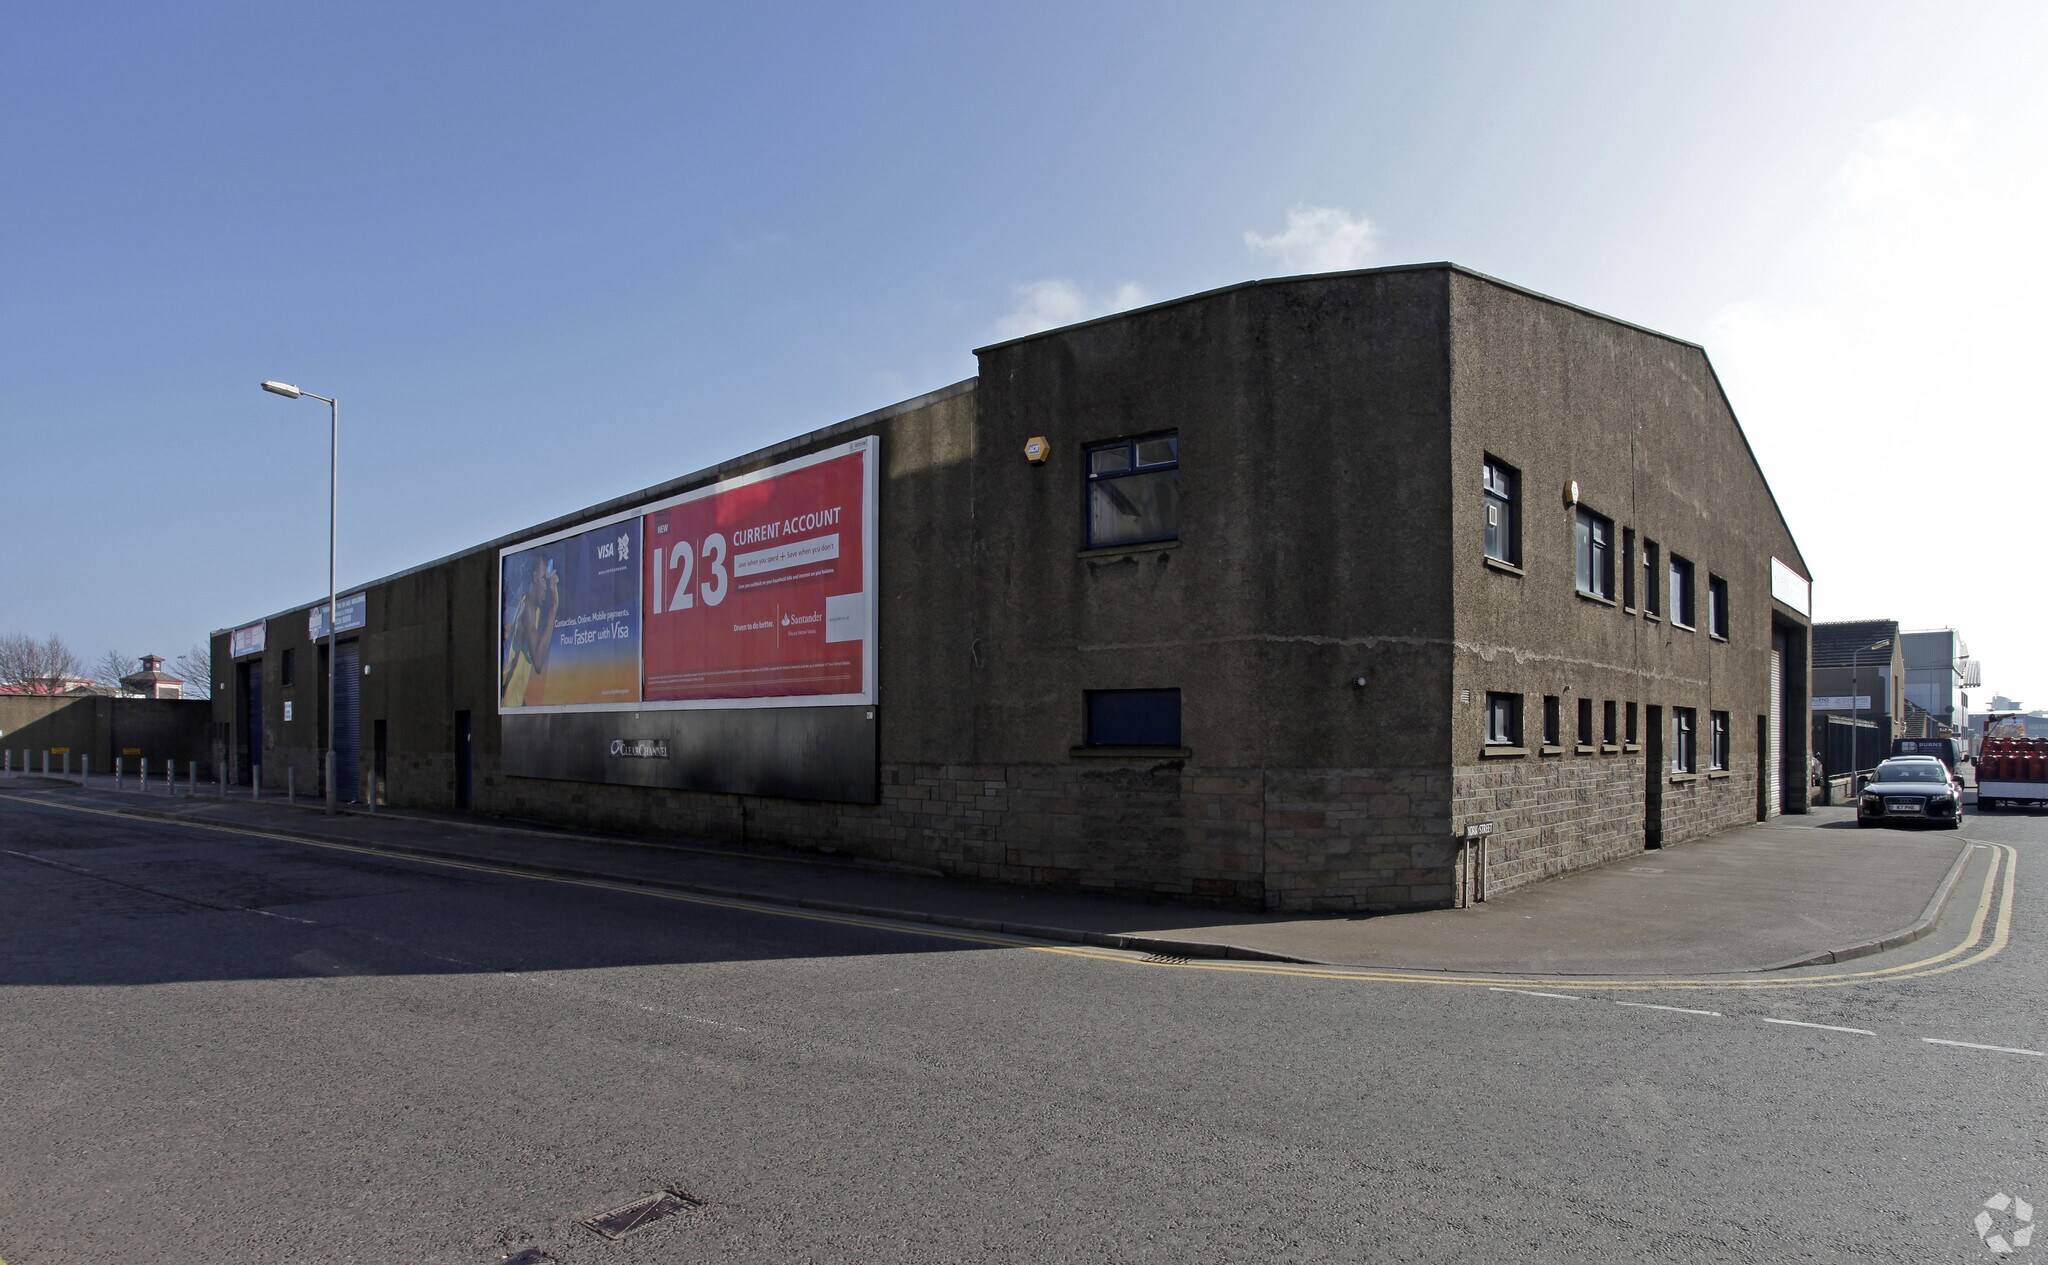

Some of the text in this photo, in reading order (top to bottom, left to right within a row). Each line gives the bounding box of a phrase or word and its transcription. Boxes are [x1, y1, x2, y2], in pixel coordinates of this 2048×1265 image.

[657, 523, 669, 534] NEW
[733, 507, 841, 546] CURRENT ACCOUNT
[597, 543, 614, 559] VISA
[747, 558, 759, 566] when
[787, 551, 797, 559] Save
[798, 548, 811, 557] when
[812, 547, 821, 556] you
[821, 543, 834, 551] don't
[592, 611, 606, 621] Mobile
[791, 611, 822, 625] Santander
[561, 621, 629, 645] Flow faster with Visa
[733, 623, 747, 632] Driven
[747, 622, 753, 630] to
[753, 621, 759, 629] do
[1479, 823, 1493, 834] STREET
